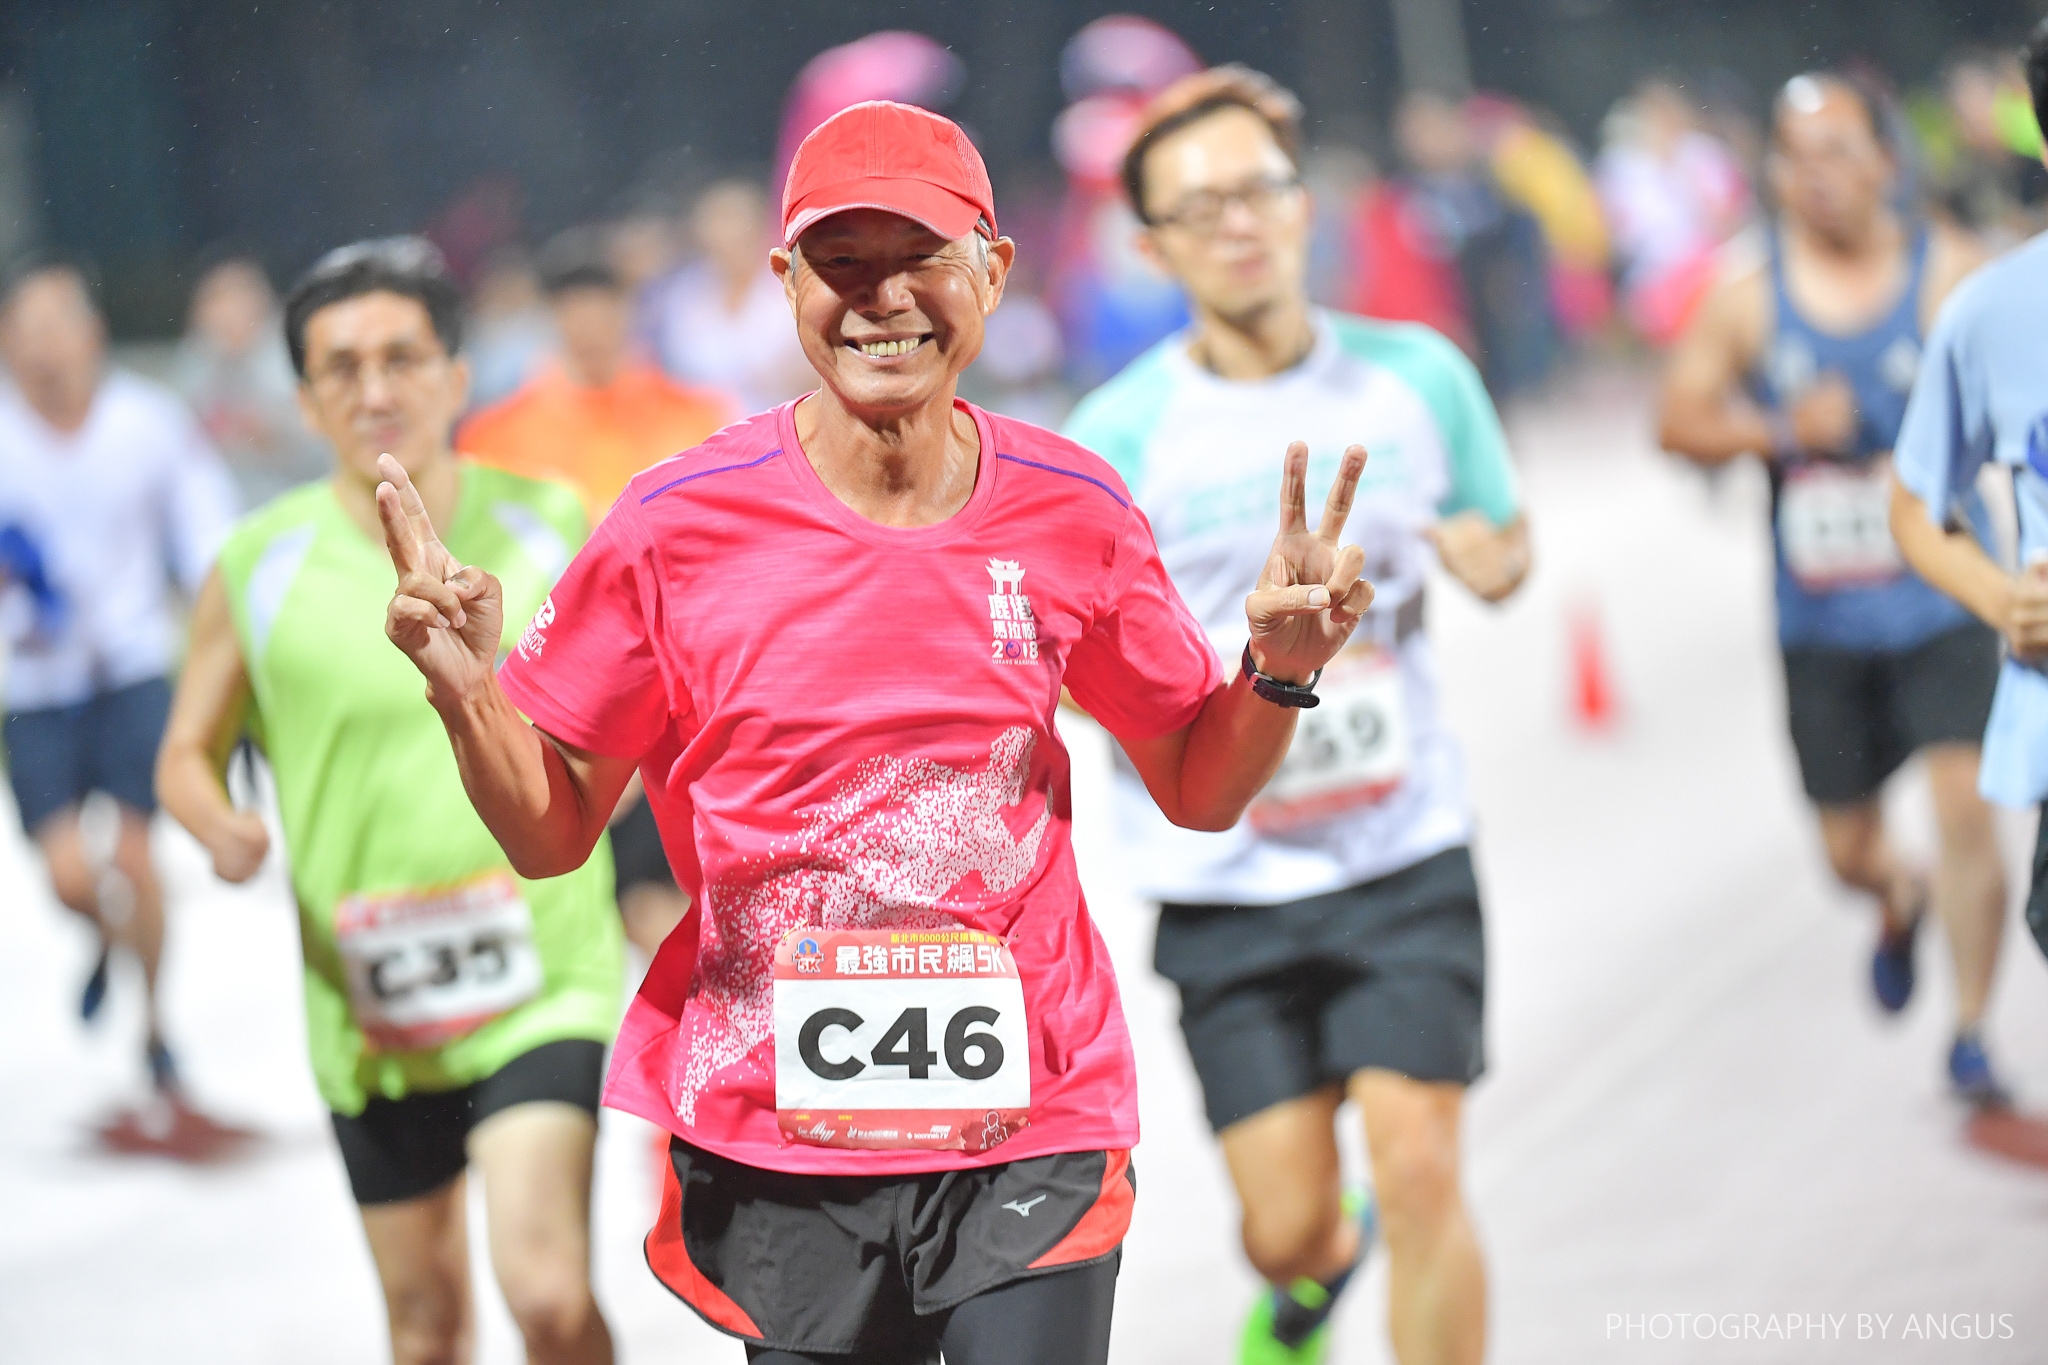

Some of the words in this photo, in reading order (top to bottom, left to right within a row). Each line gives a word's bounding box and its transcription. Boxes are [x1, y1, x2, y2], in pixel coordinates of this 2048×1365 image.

[835, 944, 1006, 975] 最強市民飆5K
[798, 1006, 1004, 1080] C46
